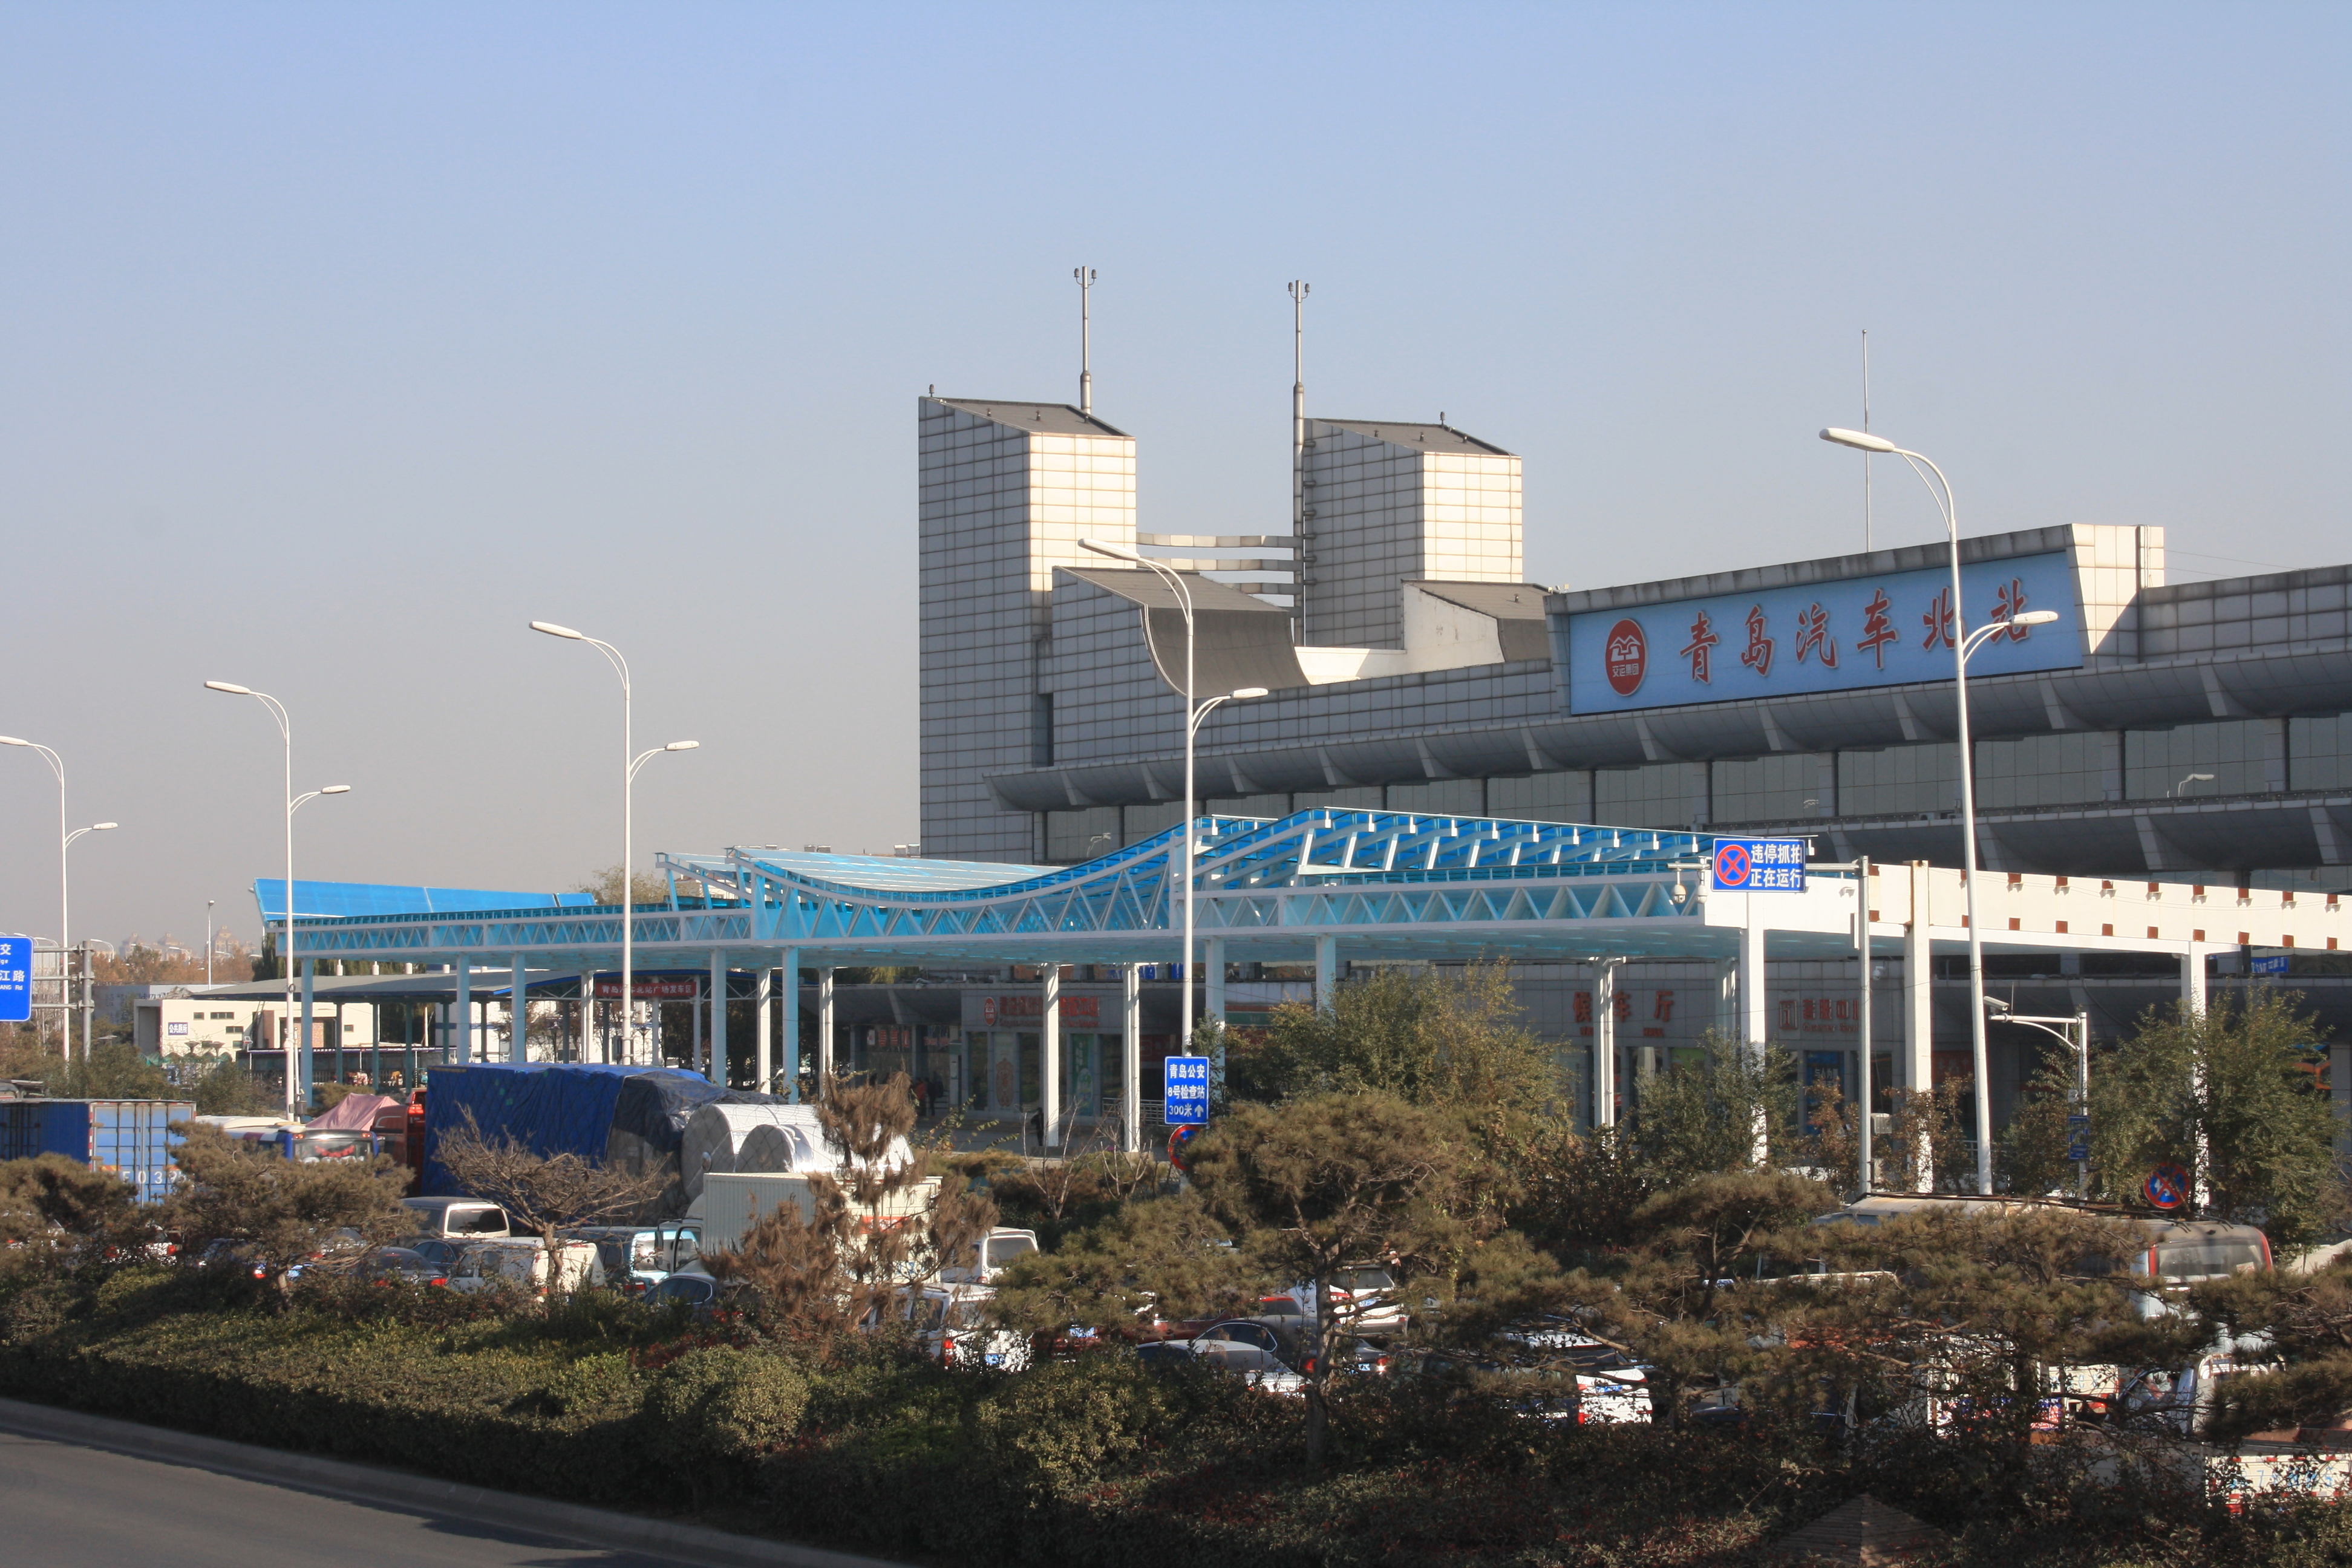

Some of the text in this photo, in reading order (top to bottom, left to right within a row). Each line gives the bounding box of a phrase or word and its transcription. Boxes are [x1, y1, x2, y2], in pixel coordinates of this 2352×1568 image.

[1680, 577, 2030, 685] 青岛汽车北站
[1612, 663, 1639, 678] 交运集团
[1750, 844, 1803, 864] 违停抓拍
[1749, 868, 1802, 887] 正在运行
[0, 970, 25, 982] 江路
[601, 984, 692, 994] 青岛车北站广场发车区
[1169, 1063, 1205, 1079] 青岛公安
[1168, 1085, 1205, 1099] 8号检查站
[1169, 1103, 1192, 1117] 300米
